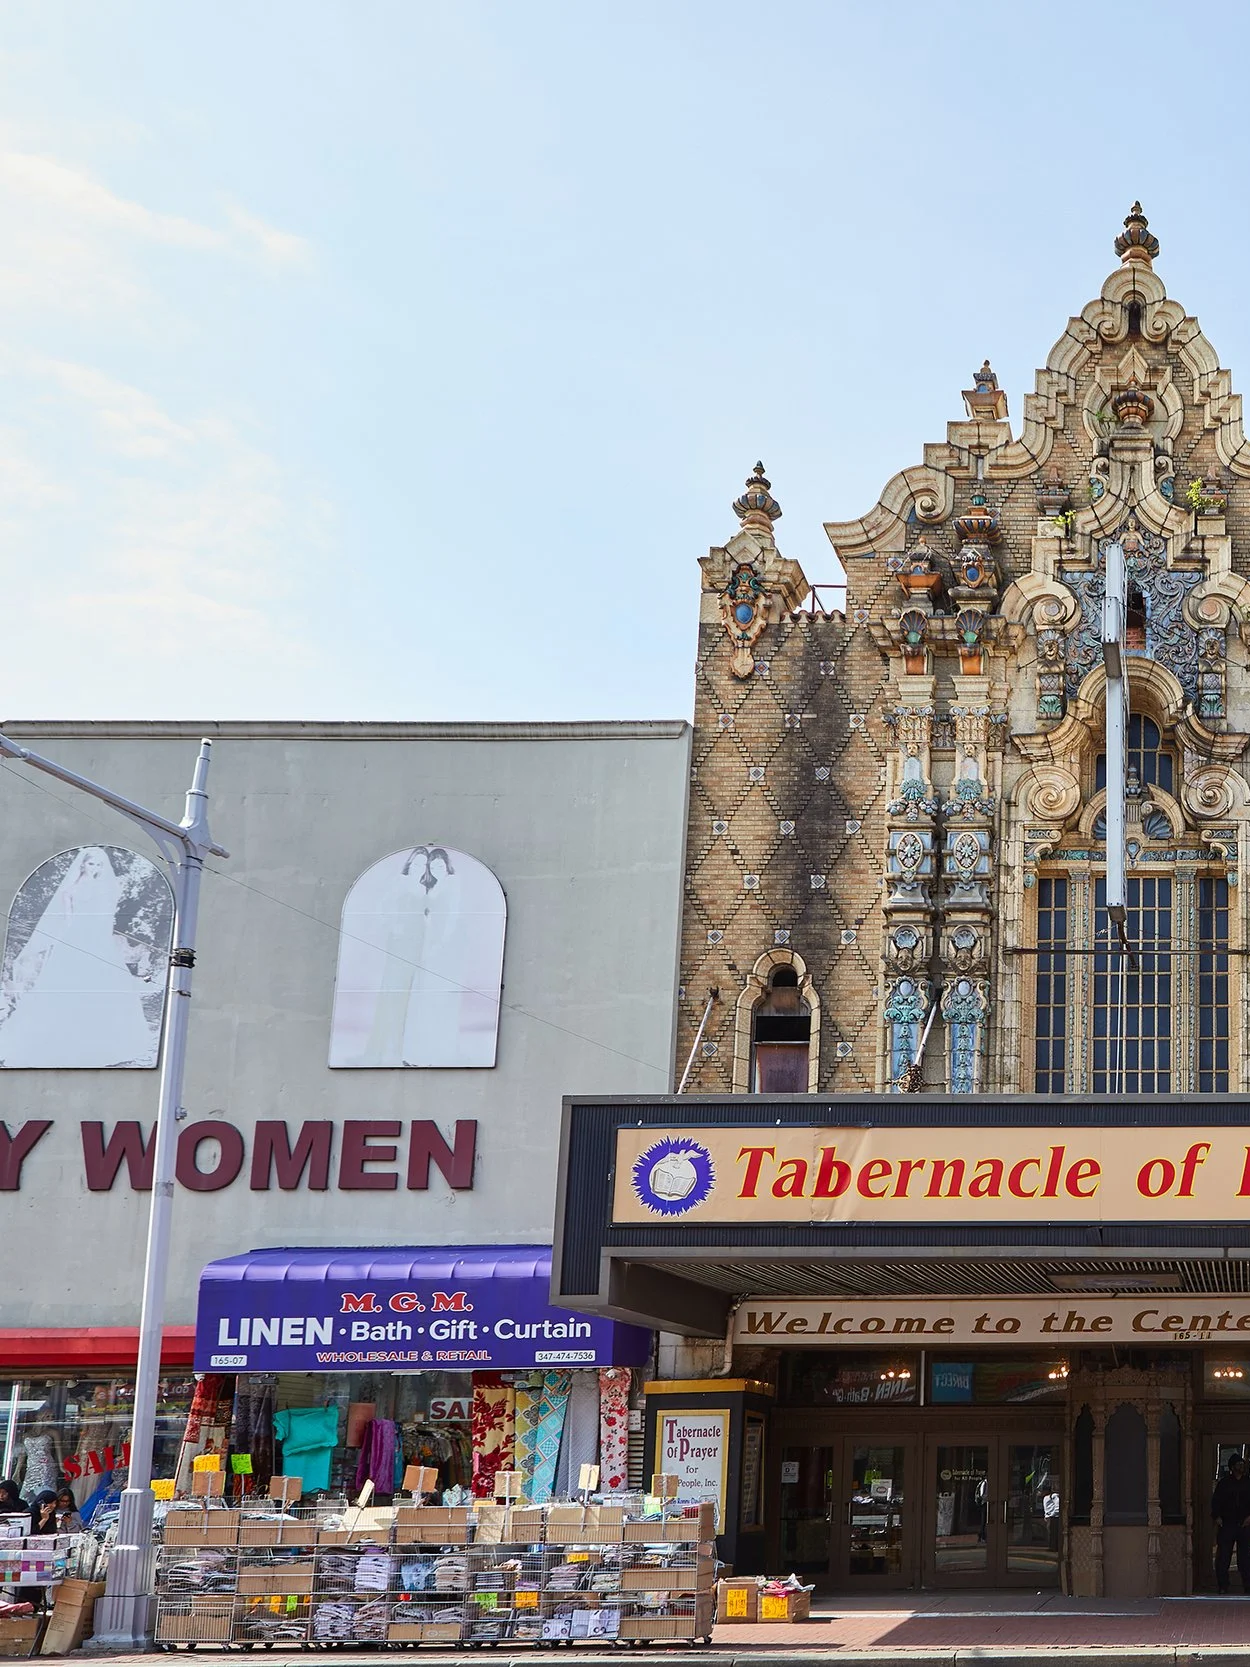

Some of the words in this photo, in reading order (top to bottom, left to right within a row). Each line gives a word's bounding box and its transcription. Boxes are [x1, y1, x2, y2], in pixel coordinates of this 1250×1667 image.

[81, 1119, 477, 1191] WOMEN
[735, 1144, 1102, 1199] Tabernacle
[1136, 1141, 1211, 1198] of
[217, 1316, 334, 1347] LINEN
[351, 1320, 412, 1341] Bath
[429, 1319, 478, 1340] Gift
[494, 1317, 591, 1340] Curtain
[741, 1311, 955, 1335] Welcome
[971, 1311, 1021, 1335] to
[1040, 1310, 1113, 1333] the
[213, 1355, 245, 1366] 165-07
[316, 1351, 418, 1363] WHOLESALE
[421, 1350, 433, 1361] &
[436, 1349, 491, 1361] RETAIL
[538, 1351, 594, 1361] 347-474-7536
[666, 1419, 721, 1443] Tabernacle
[667, 1446, 678, 1459] Of
[679, 1438, 719, 1461] Prayer
[686, 1465, 699, 1474] for
[705, 1479, 718, 1487] Inc.
